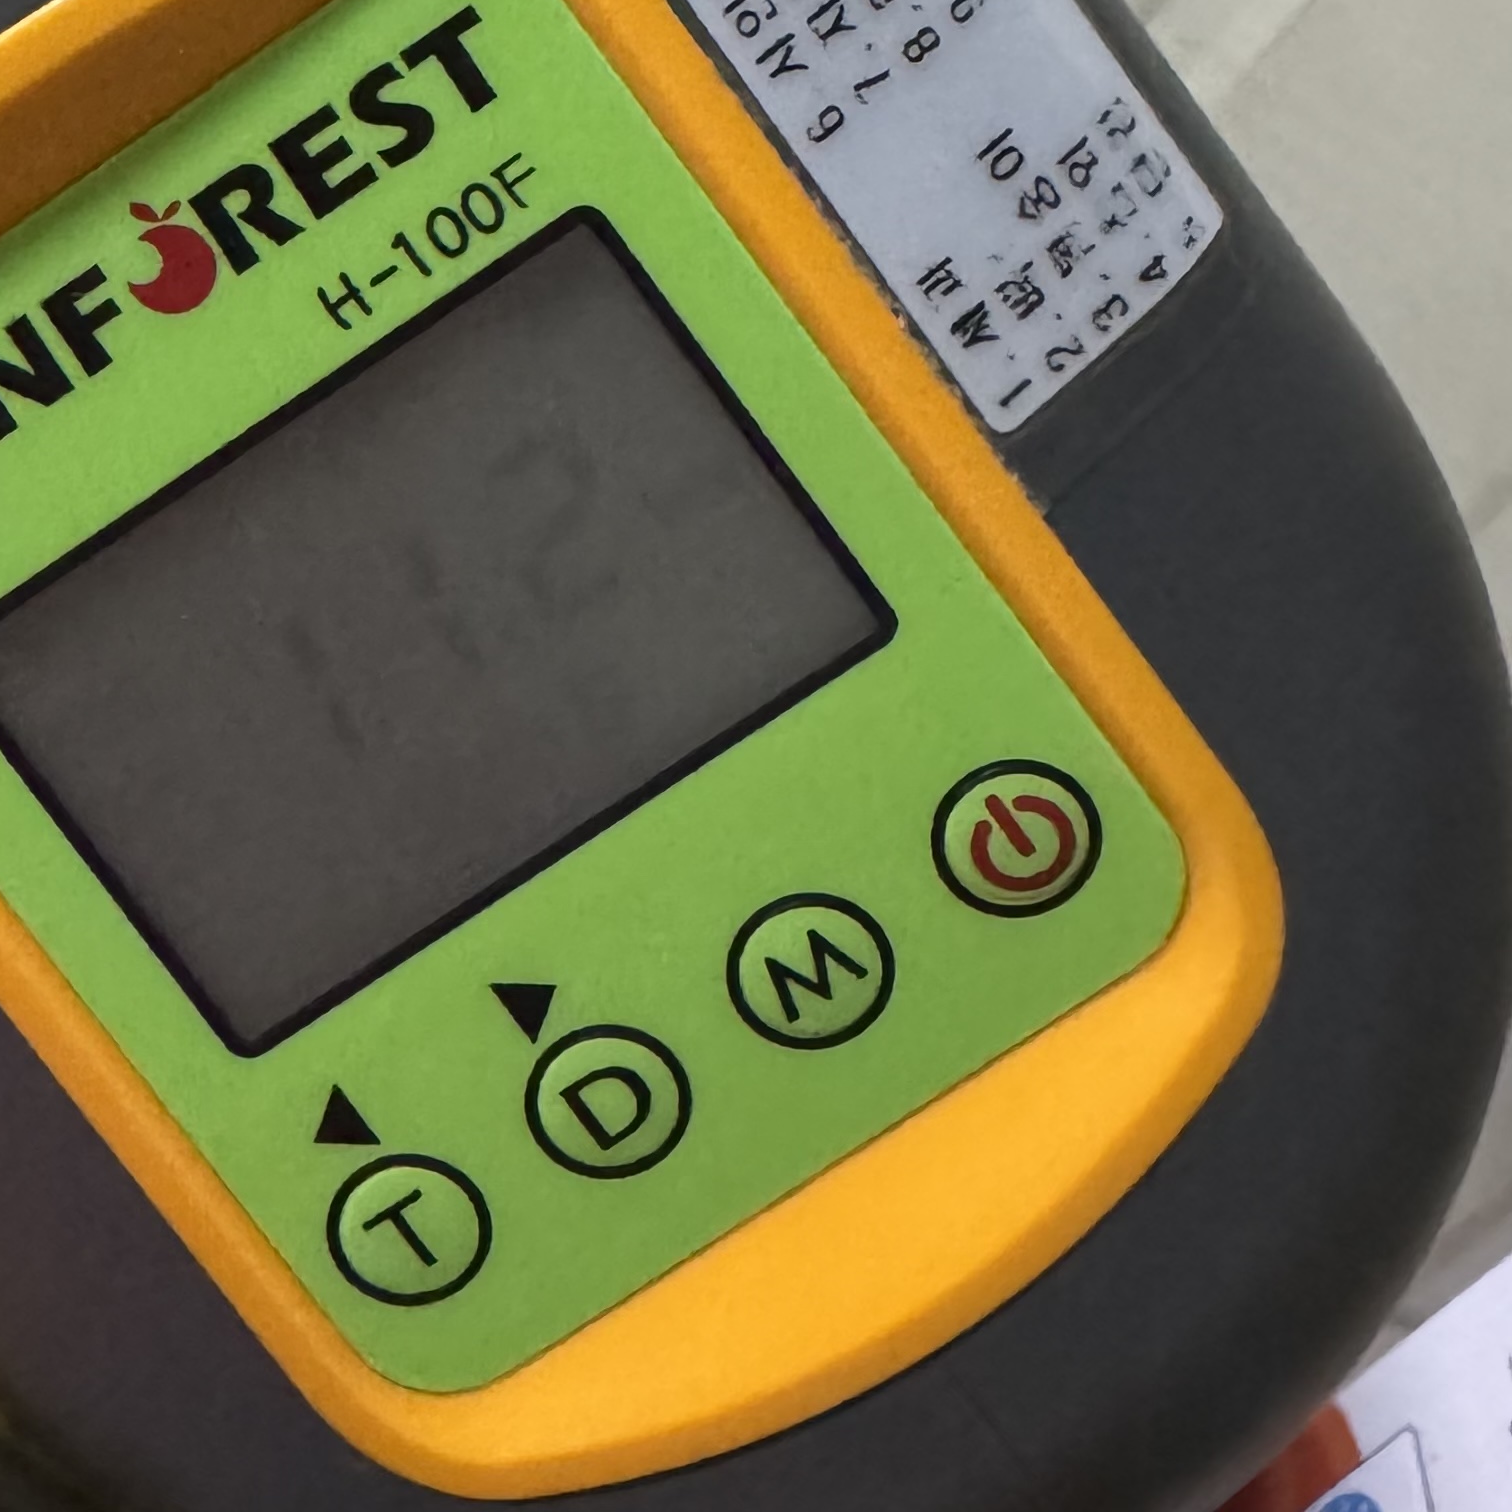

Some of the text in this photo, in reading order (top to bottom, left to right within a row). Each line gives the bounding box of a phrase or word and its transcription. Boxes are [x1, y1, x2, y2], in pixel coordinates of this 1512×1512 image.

[316, 152, 536, 330] H-100F
[764, 929, 868, 1024] M
[558, 1066, 652, 1151] D
[363, 1189, 439, 1268] T
